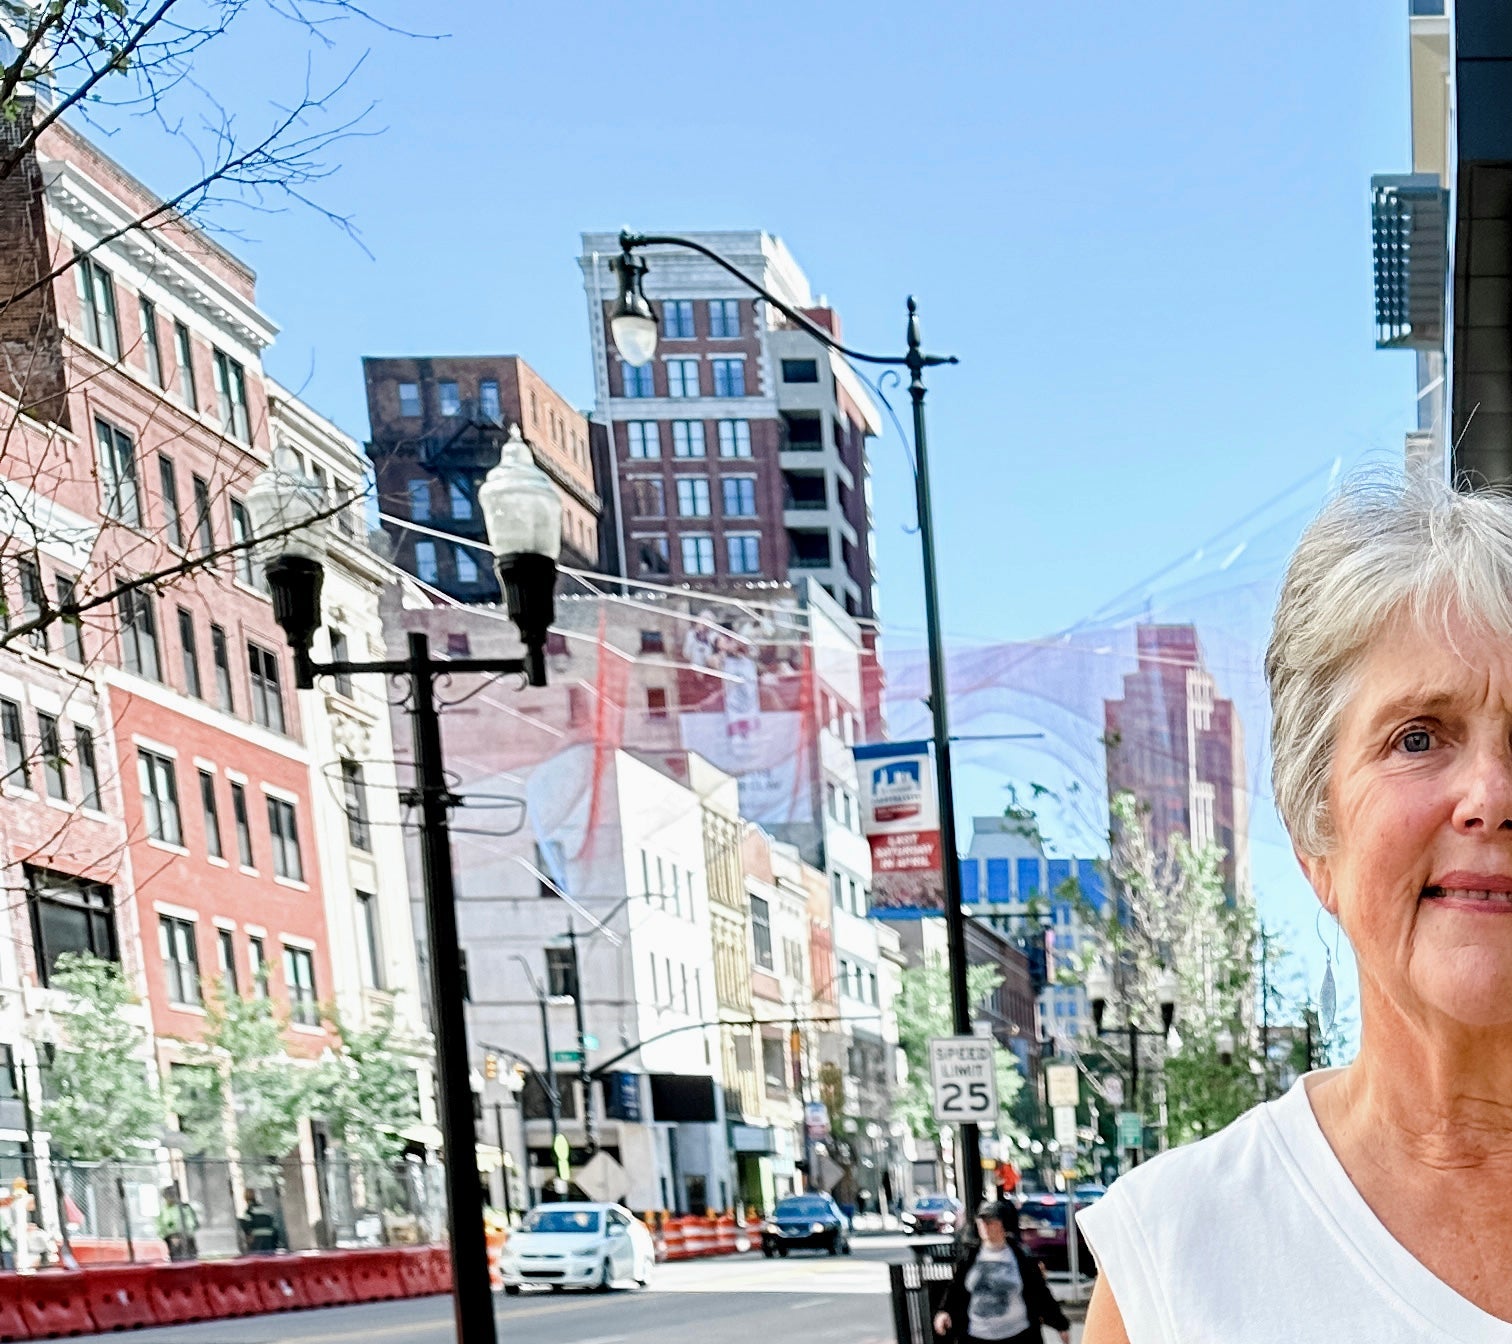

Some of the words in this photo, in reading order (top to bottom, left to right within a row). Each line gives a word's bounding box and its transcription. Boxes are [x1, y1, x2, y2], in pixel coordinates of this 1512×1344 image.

[936, 1048, 989, 1060] SPEED
[942, 1064, 983, 1078] LIMIT
[942, 1083, 990, 1111] 25
